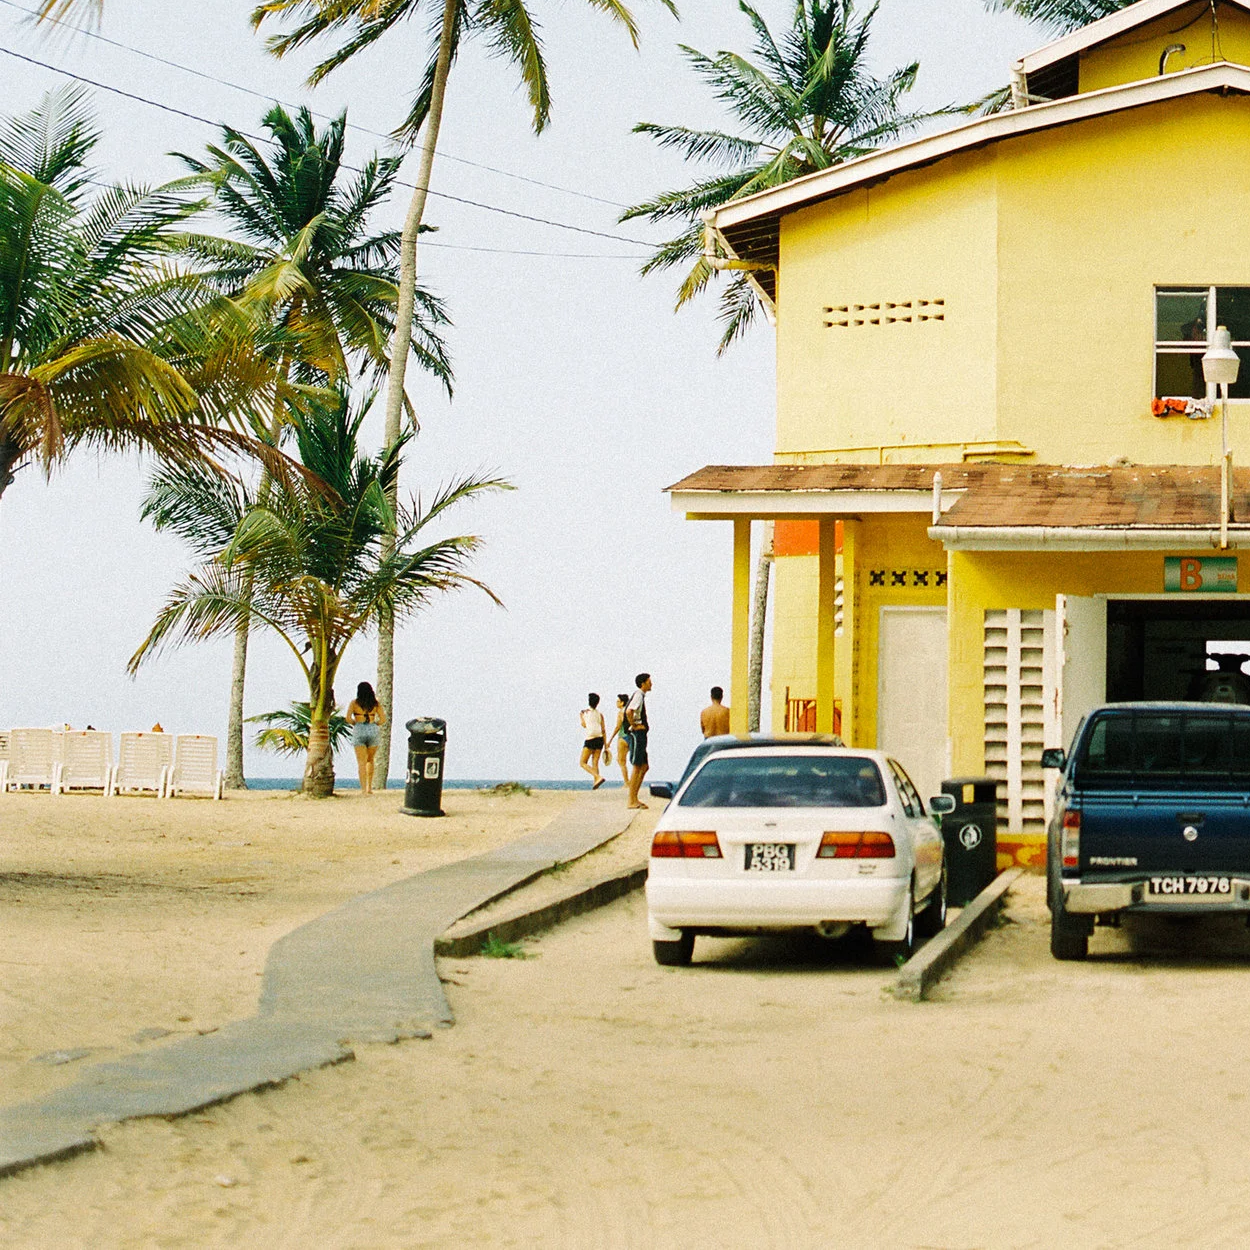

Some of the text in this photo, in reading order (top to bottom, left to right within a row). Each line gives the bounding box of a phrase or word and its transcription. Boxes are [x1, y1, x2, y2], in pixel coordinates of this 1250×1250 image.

[1180, 558, 1203, 591] B
[752, 844, 788, 858] PBG
[750, 857, 790, 871] 5319
